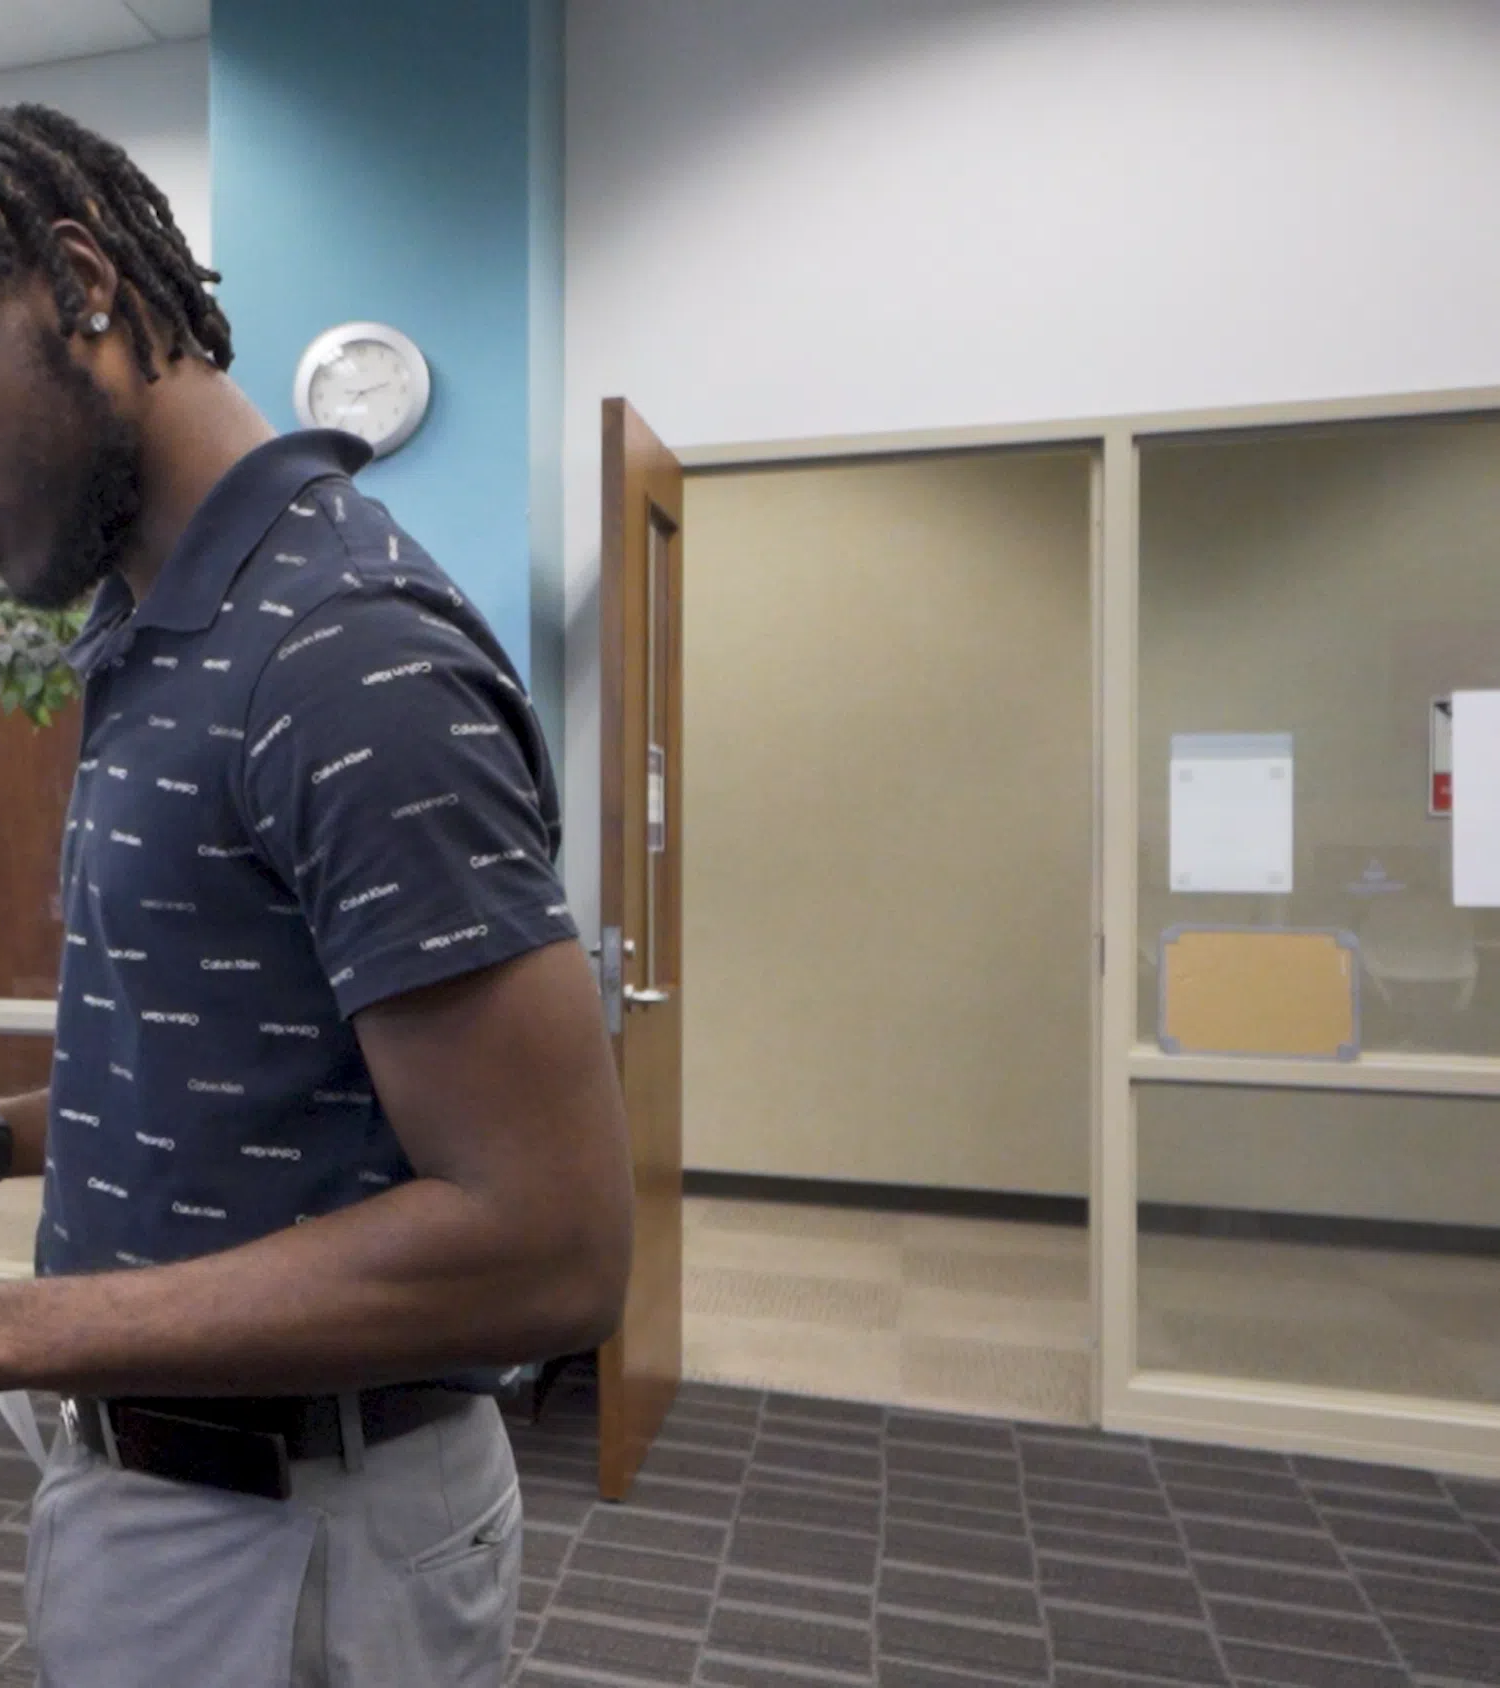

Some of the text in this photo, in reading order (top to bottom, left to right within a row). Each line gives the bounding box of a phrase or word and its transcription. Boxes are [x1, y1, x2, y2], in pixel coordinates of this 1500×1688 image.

[277, 633, 314, 661] Calvin
[361, 659, 432, 686] Calvin Klein
[312, 747, 373, 785] Calvin Klein
[420, 792, 458, 815] Calvin
[340, 882, 400, 912] Calvin Klein
[419, 923, 488, 951] Calvin Klein
[200, 958, 260, 971] Calvin Klein
[141, 1011, 199, 1027] Calvin Klein
[284, 1024, 320, 1039] Calvin
[187, 1077, 244, 1095] Calvin Klein
[266, 1146, 301, 1161] Calvin
